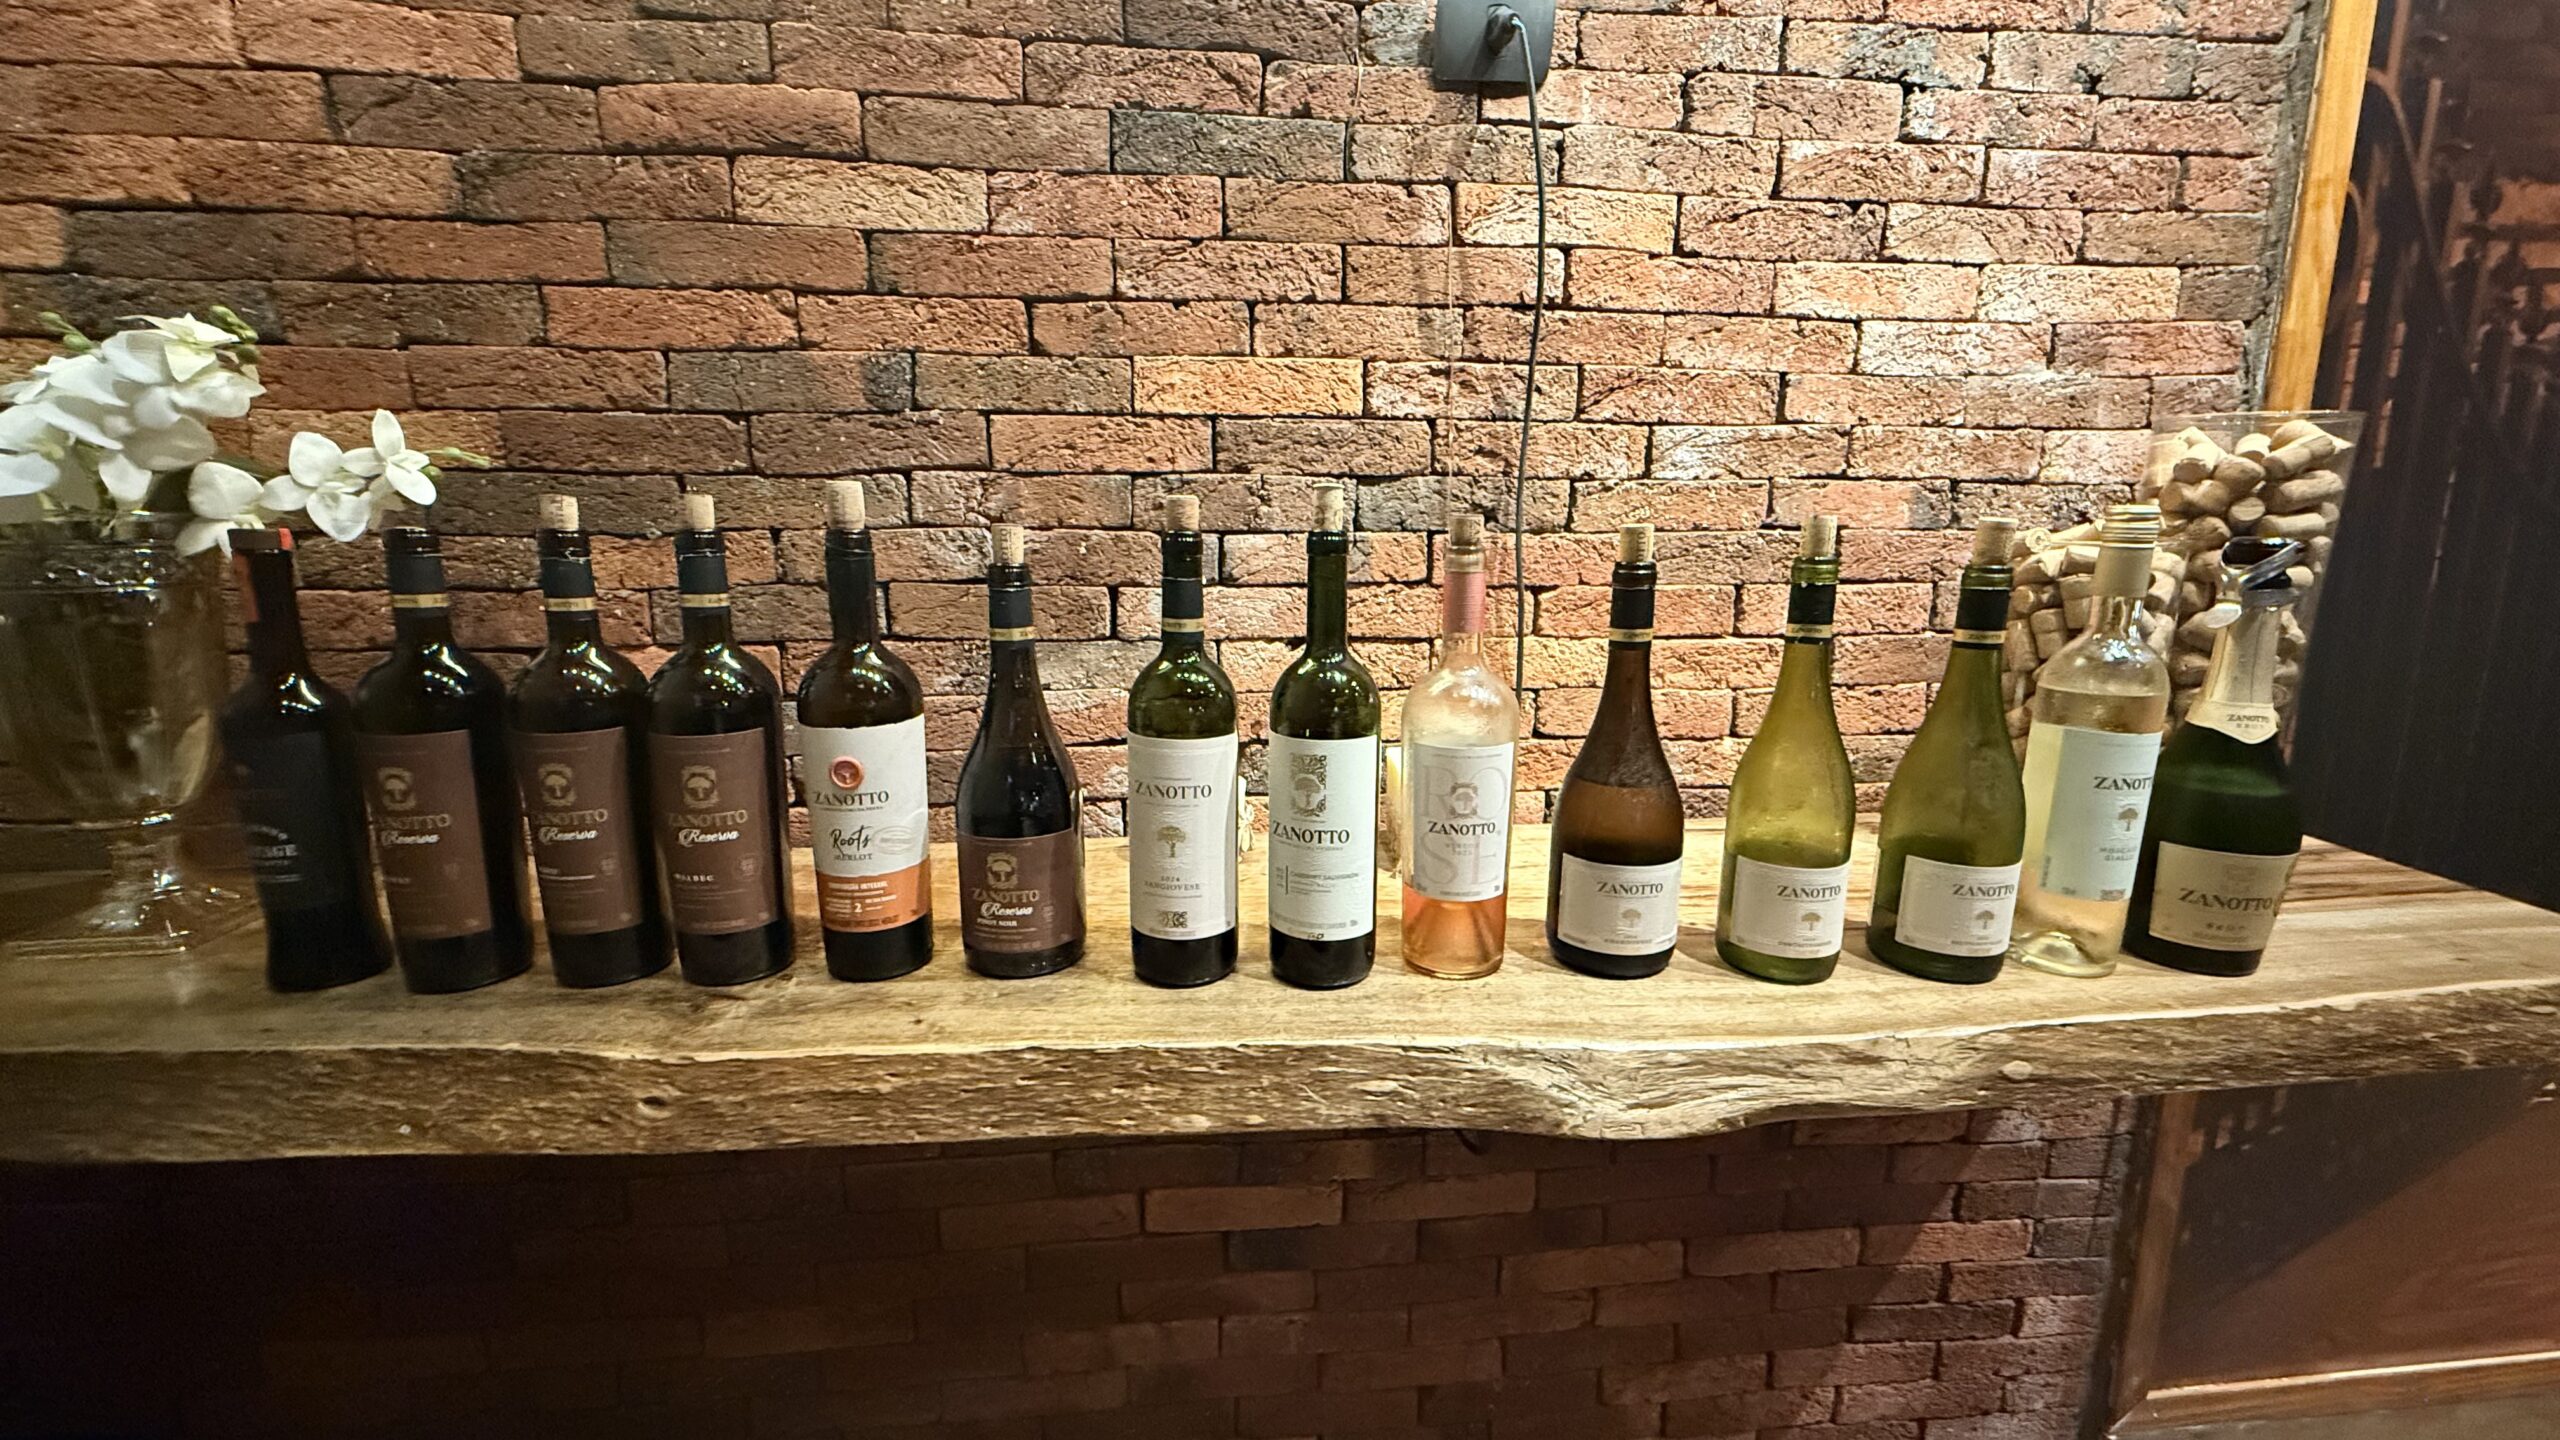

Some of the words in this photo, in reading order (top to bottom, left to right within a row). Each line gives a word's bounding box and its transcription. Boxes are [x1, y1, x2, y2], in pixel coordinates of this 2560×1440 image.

[2226, 713, 2270, 724] ZANOTTO
[812, 790, 890, 805] ZANOTTO
[1134, 779, 1212, 800] ZANOTTO
[374, 813, 452, 830] ANOTTO
[531, 808, 609, 826] ANOTTO
[668, 809, 749, 828] ZANOTTO
[539, 826, 599, 846] Reserva
[1272, 820, 1351, 845] ZANOTTO
[1427, 820, 1496, 836] ZANOTTO
[678, 828, 740, 848] Reserva
[830, 824, 873, 857] Roots
[971, 888, 1040, 903] ZANOTTO
[1596, 881, 1664, 895] ZANOTTO
[1777, 884, 1841, 899] ZANOTTO
[1952, 883, 2015, 898] ZANOTTO
[854, 902, 863, 913] 2
[2178, 887, 2273, 912] ZANOTTO
[980, 901, 1034, 919] Reserva
